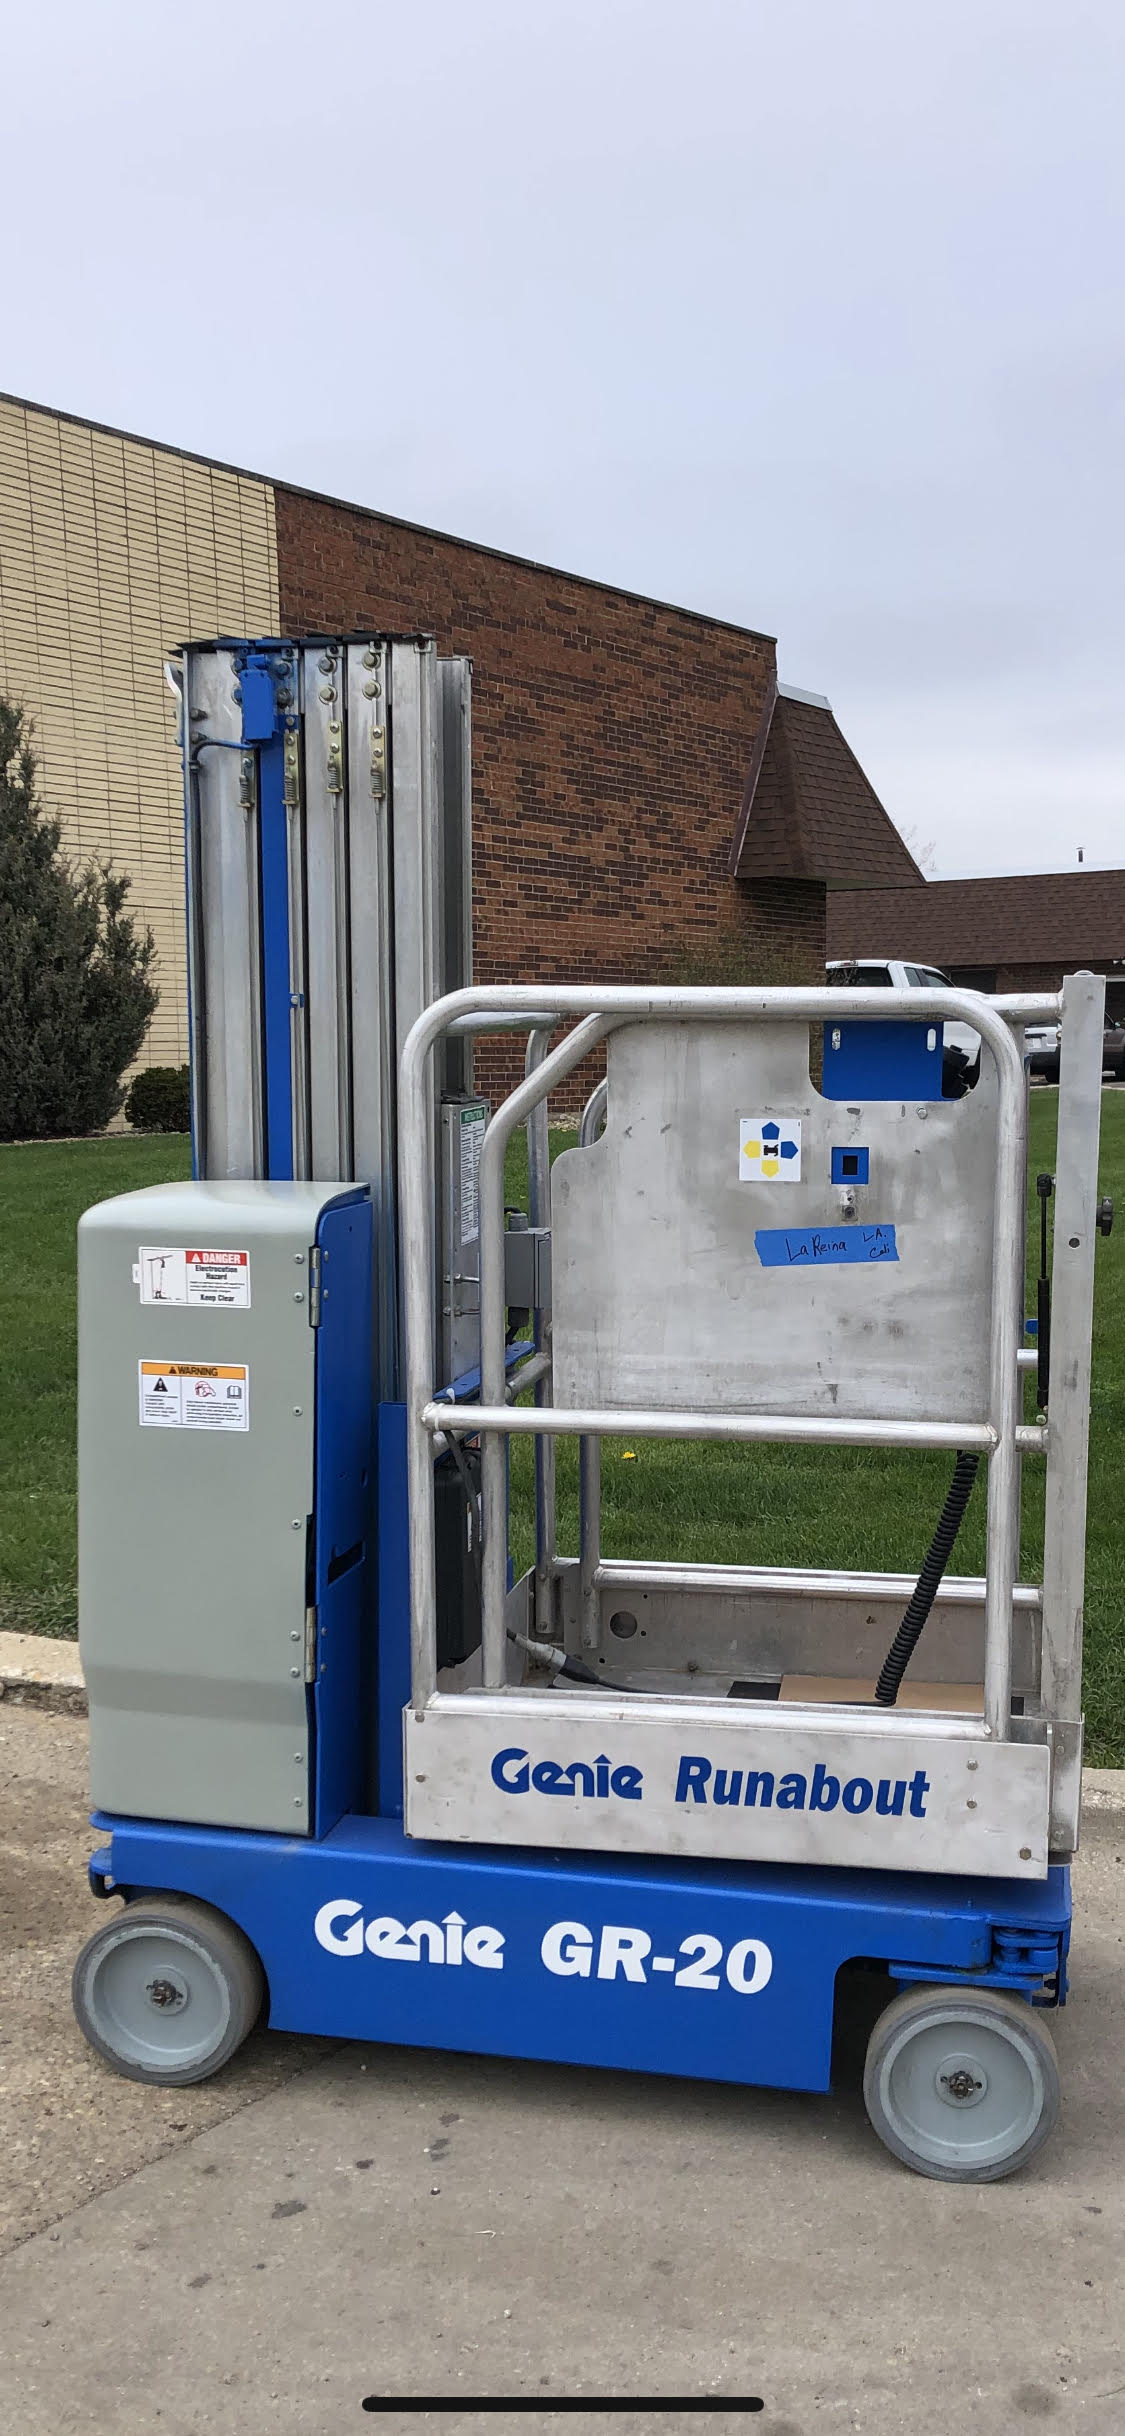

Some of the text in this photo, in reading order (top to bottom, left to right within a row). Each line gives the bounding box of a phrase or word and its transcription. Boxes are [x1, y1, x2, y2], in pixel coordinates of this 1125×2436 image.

[811, 1233, 848, 1257] Reina
[202, 1252, 241, 1264] DANGER
[200, 1294, 235, 1302] Keep Clear
[177, 1366, 218, 1376] WARNING
[490, 1747, 931, 1818] Genie Runabout
[314, 1898, 773, 1995] Genie GR-20
